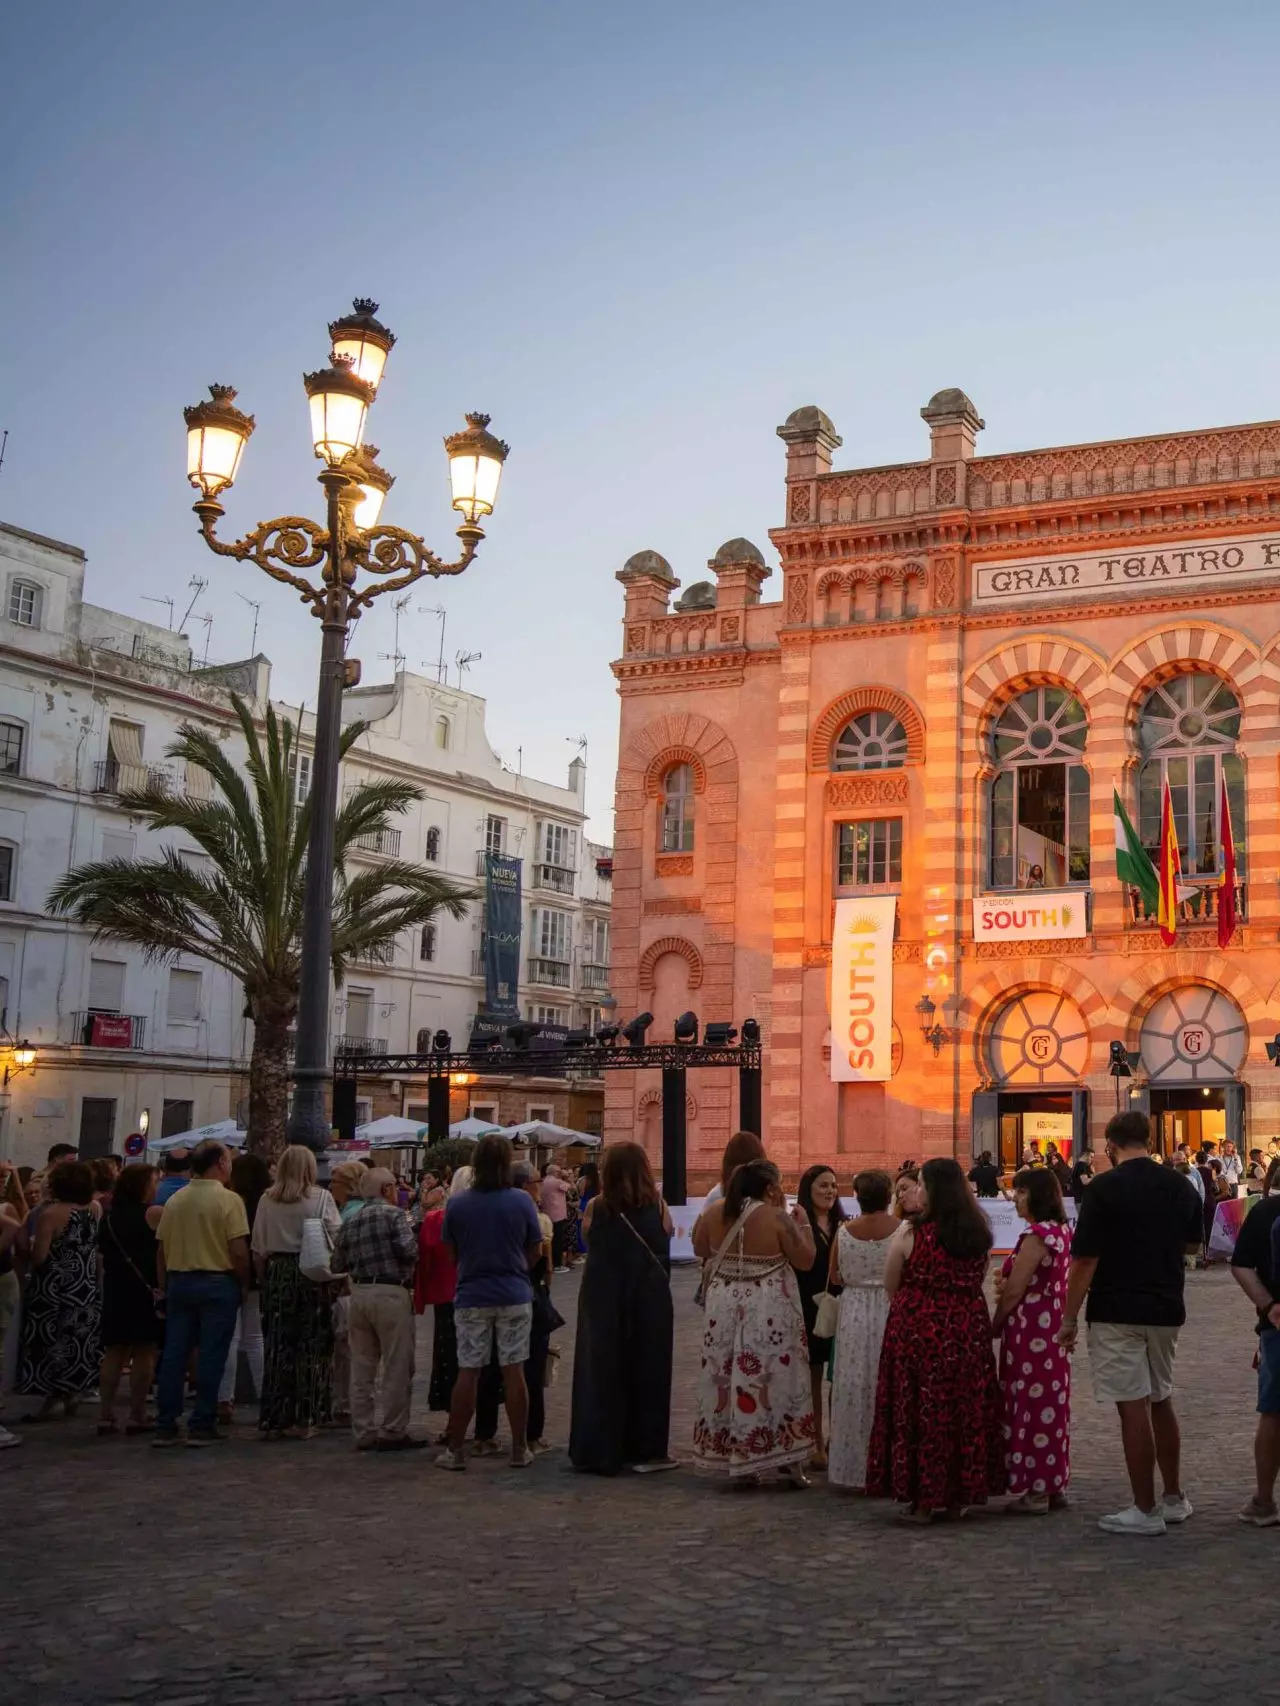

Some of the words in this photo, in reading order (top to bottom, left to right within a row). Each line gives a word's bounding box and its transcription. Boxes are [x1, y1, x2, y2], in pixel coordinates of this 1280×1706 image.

[991, 564, 1080, 593] GRAN
[1099, 547, 1245, 582] TEATRO
[492, 866, 517, 880] NUEVA
[982, 909, 1057, 930] SOUTH
[849, 942, 875, 1069] SOUTH
